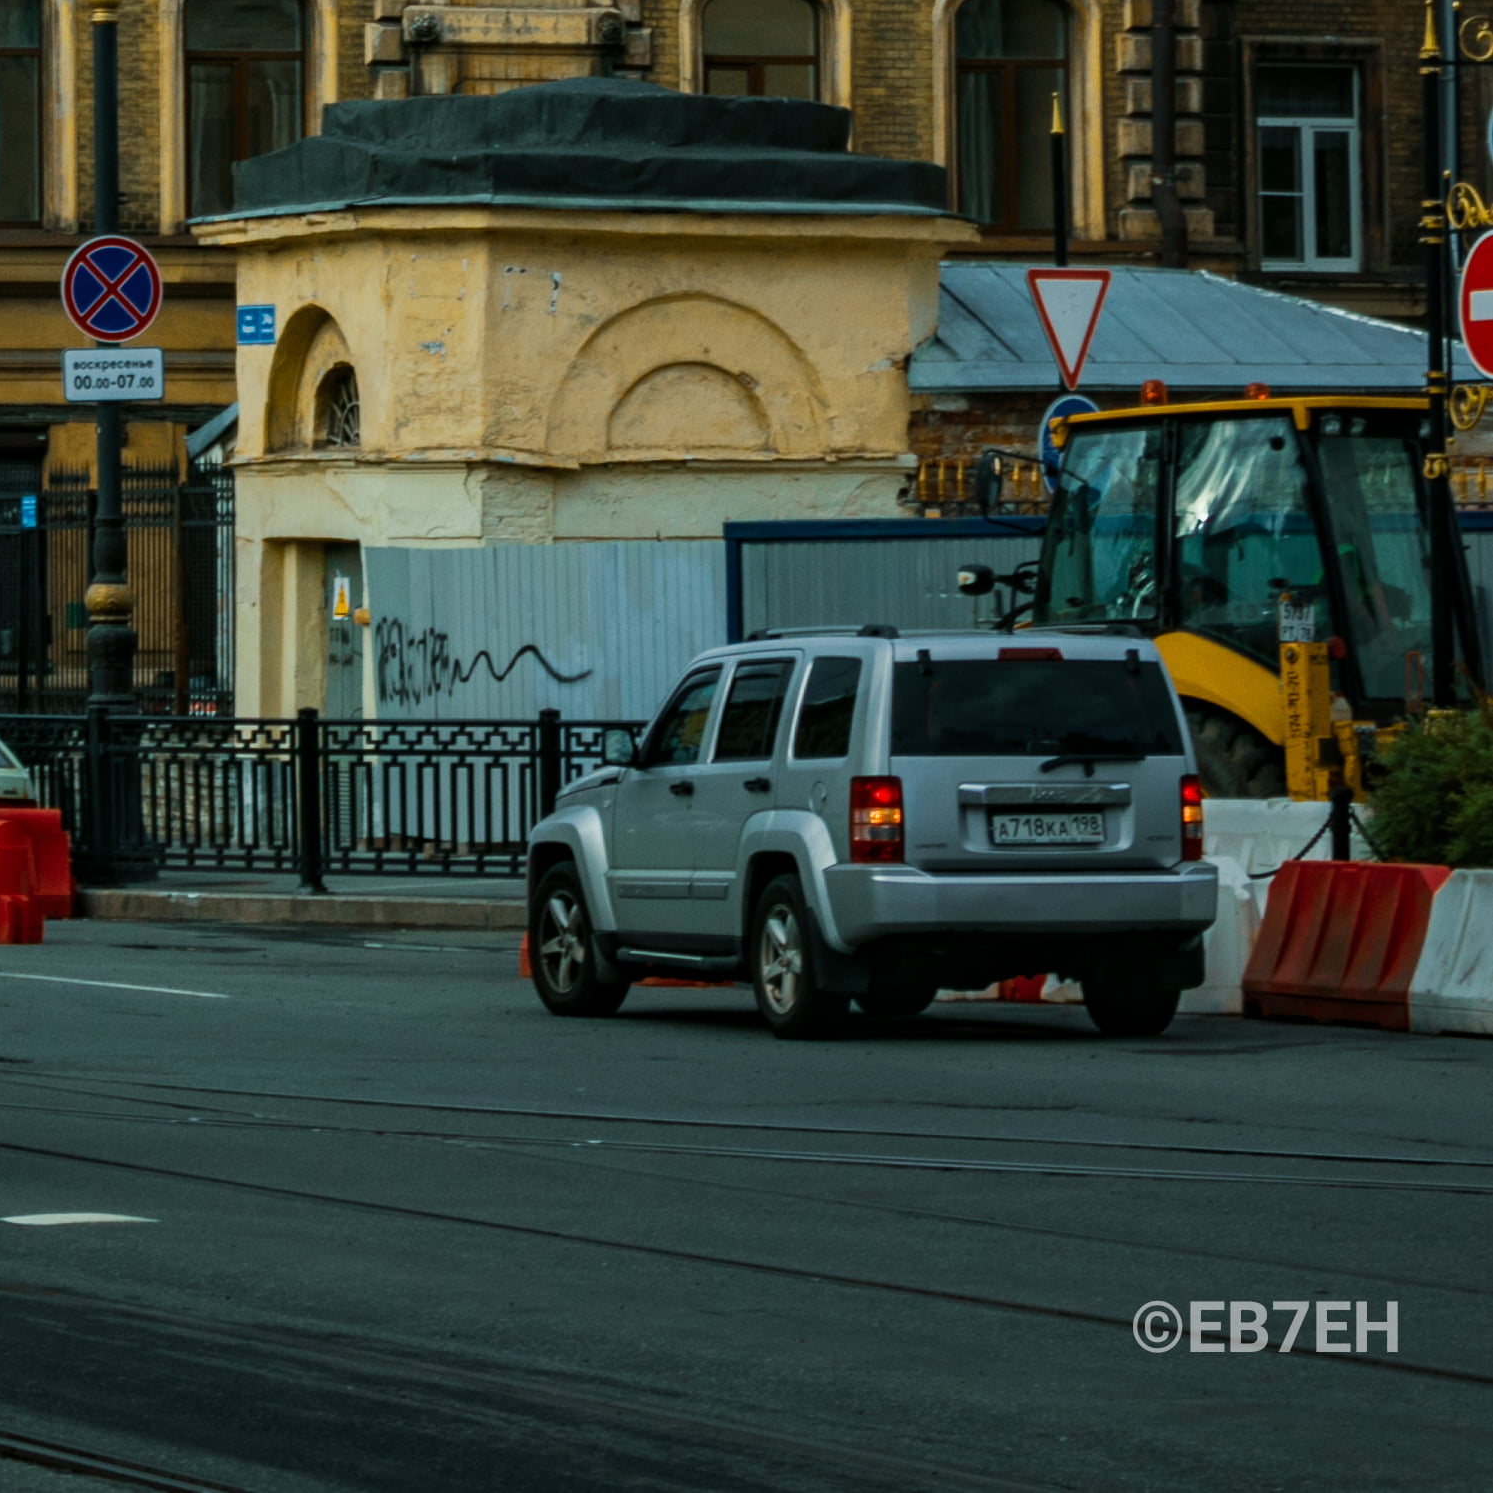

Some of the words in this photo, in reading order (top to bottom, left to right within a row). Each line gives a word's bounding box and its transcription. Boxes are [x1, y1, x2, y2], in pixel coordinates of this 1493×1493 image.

[73, 359, 154, 372] воскресенье
[998, 818, 1068, 838] А718КА
[1071, 815, 1099, 833] 198
